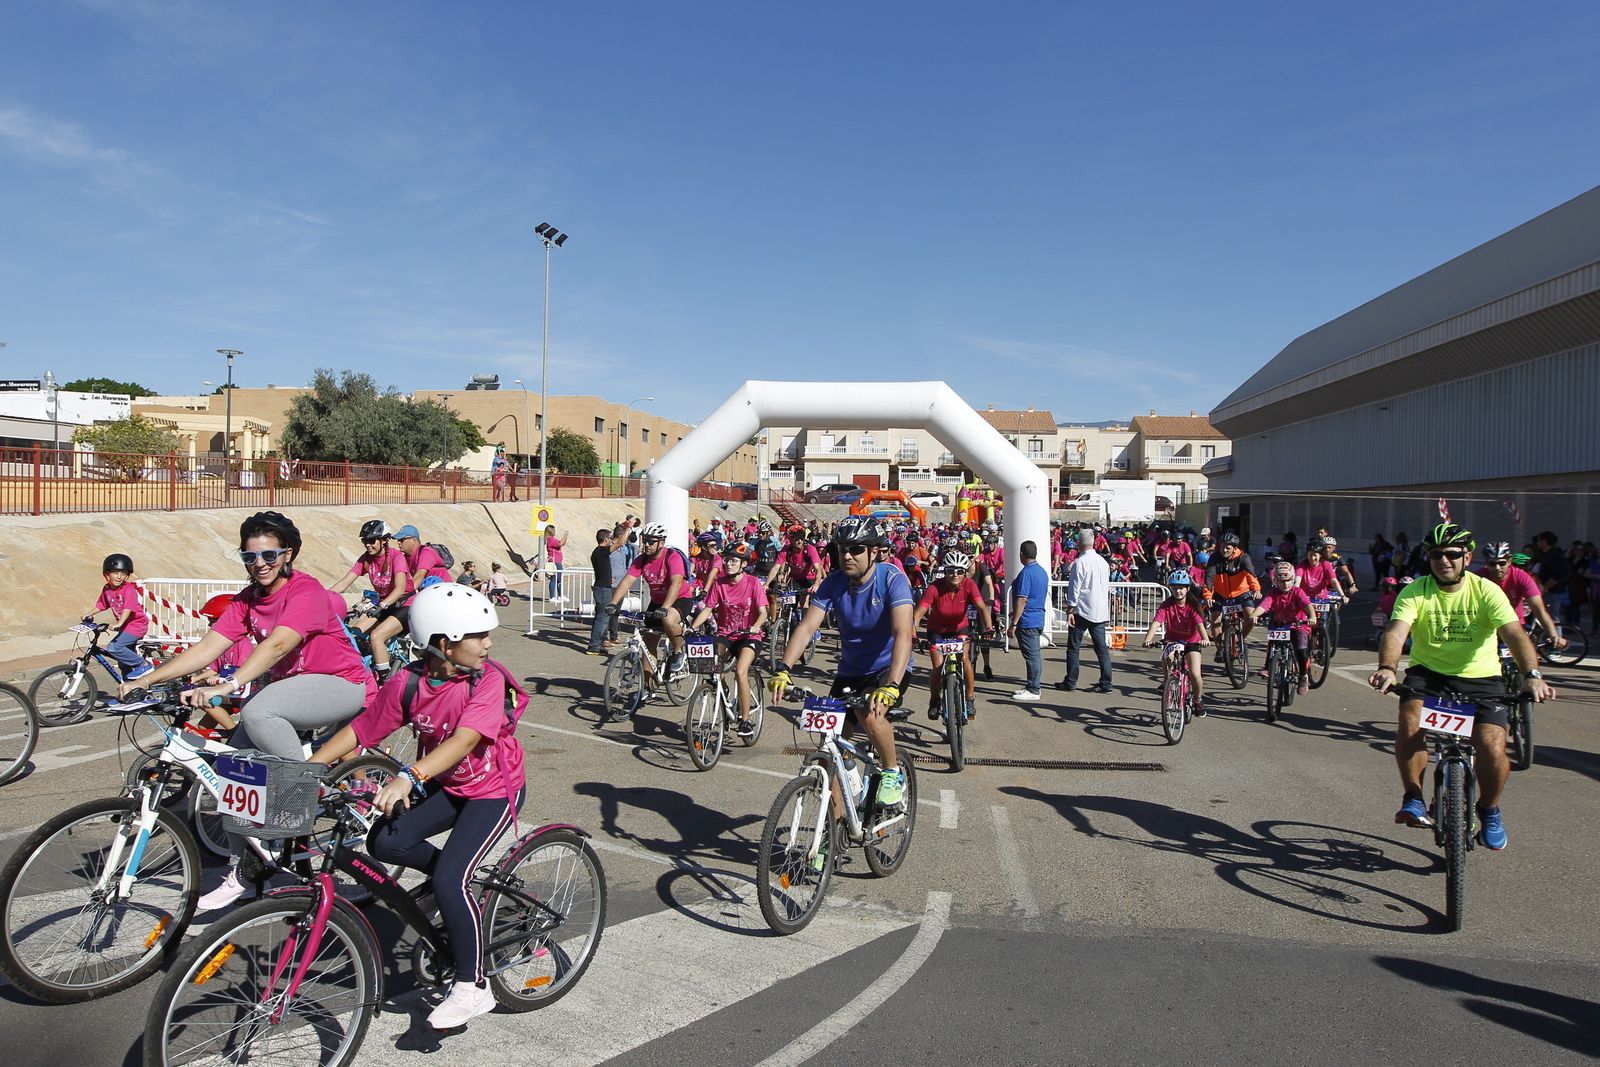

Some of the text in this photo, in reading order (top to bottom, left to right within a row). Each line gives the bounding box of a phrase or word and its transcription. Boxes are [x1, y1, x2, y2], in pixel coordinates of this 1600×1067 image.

[1269, 631, 1287, 640] 473
[690, 646, 711, 656] 046
[940, 643, 959, 654] 182
[803, 712, 838, 730] 369
[1425, 712, 1467, 732] 477
[223, 784, 259, 816] 490
